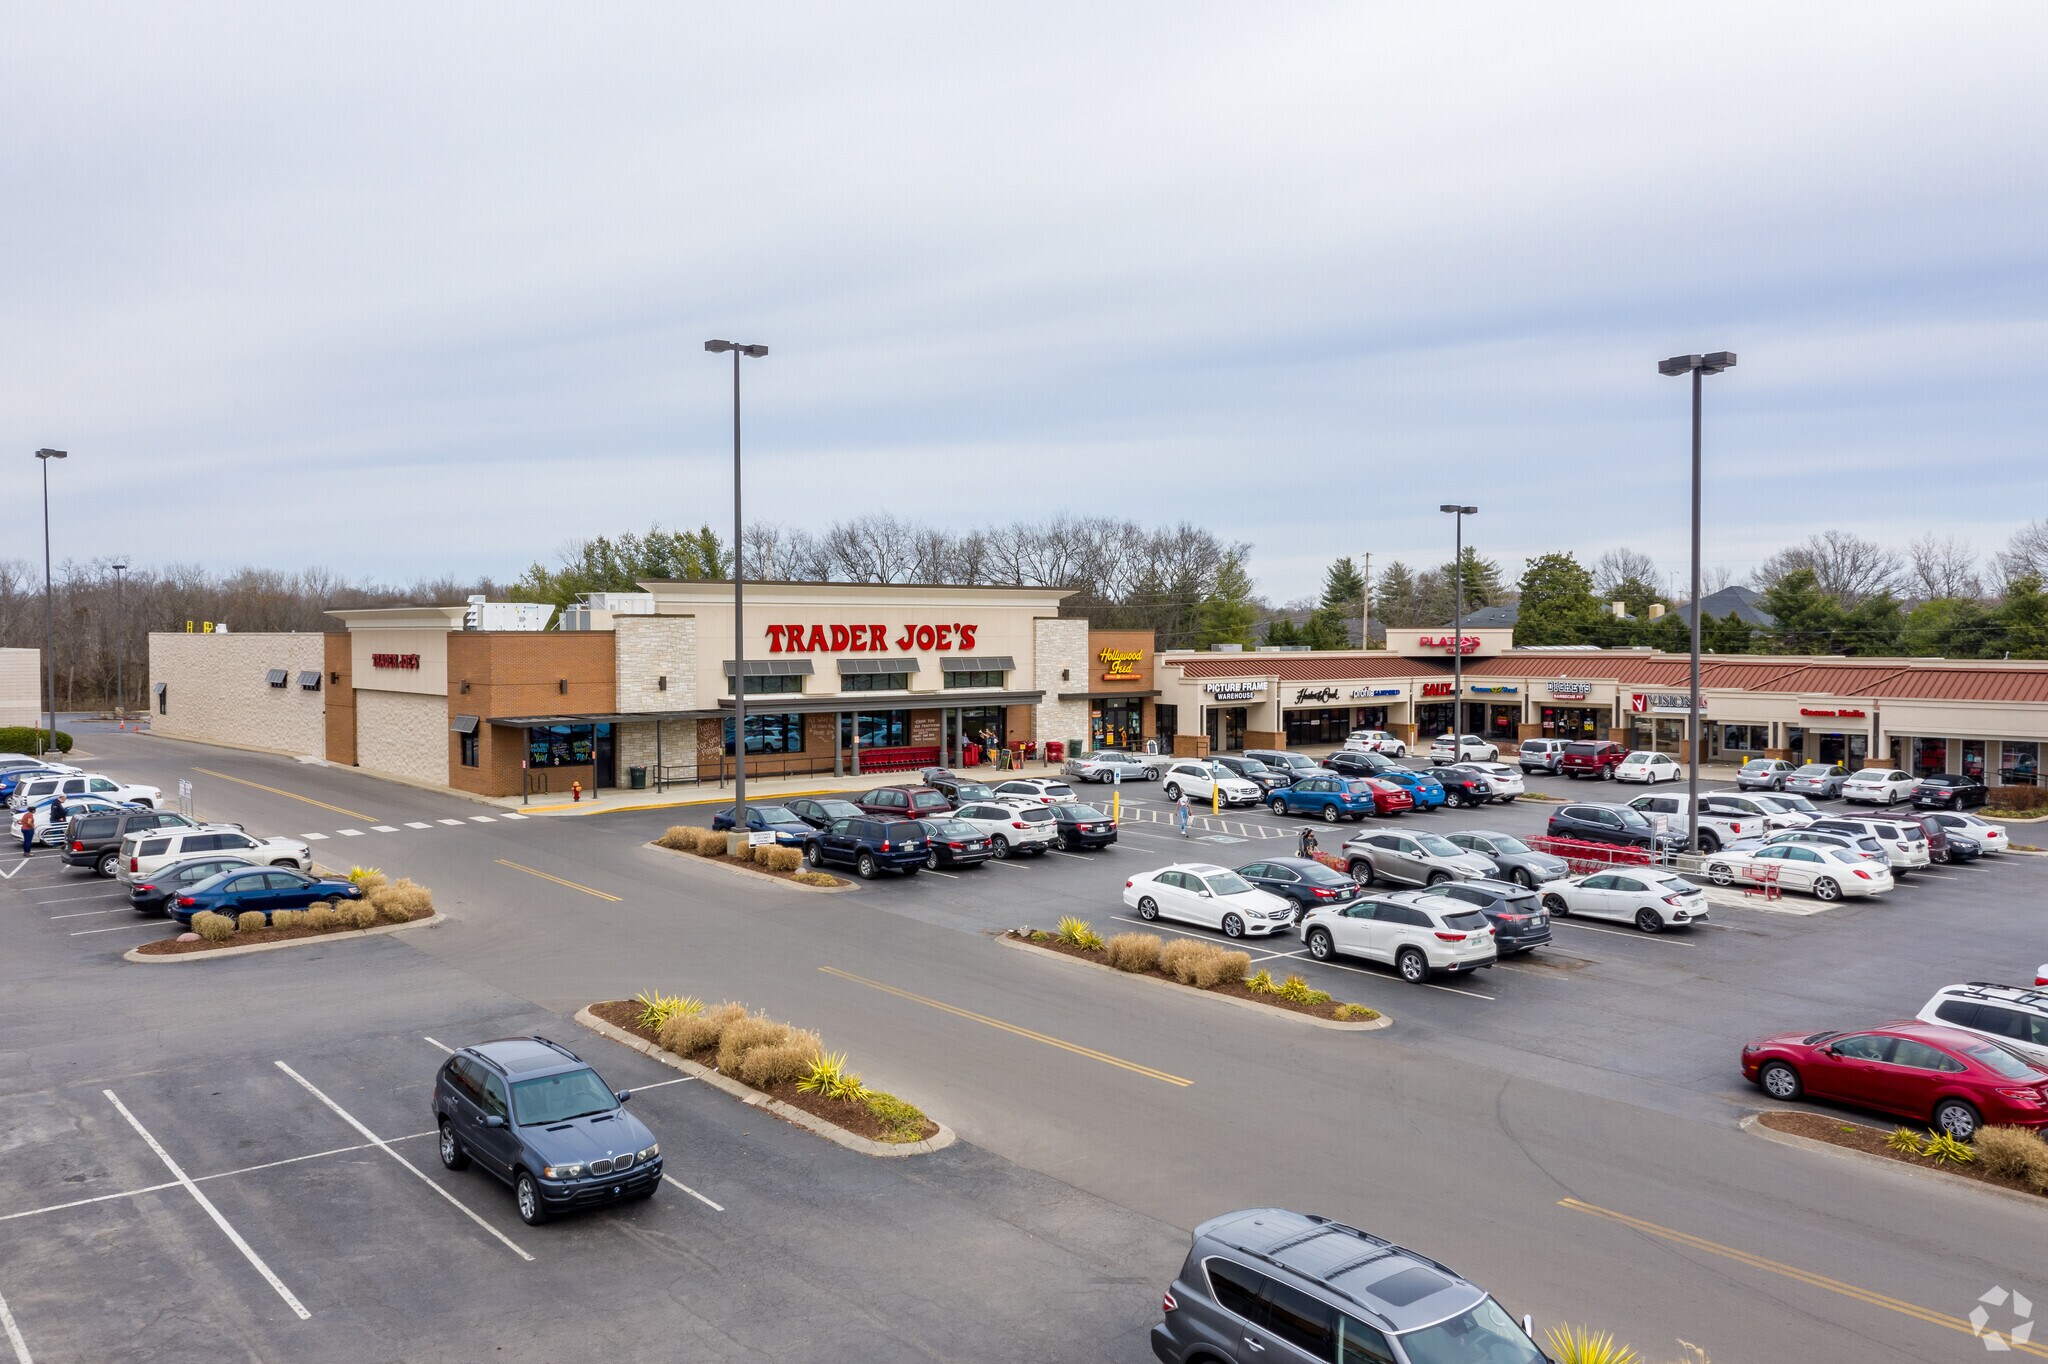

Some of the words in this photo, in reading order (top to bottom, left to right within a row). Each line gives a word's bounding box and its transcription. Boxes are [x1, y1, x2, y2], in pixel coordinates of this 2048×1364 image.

[765, 624, 889, 652] TRADER
[895, 622, 978, 651] JOE'S
[372, 653, 399, 668] TRADER
[1100, 647, 1143, 663] Hollywood
[1109, 661, 1133, 674] Feed
[1206, 683, 1241, 692] PICTURE
[1242, 682, 1268, 691] FRAME
[1423, 683, 1452, 696] SALLY
[1217, 692, 1254, 700] WAREHOUSE
